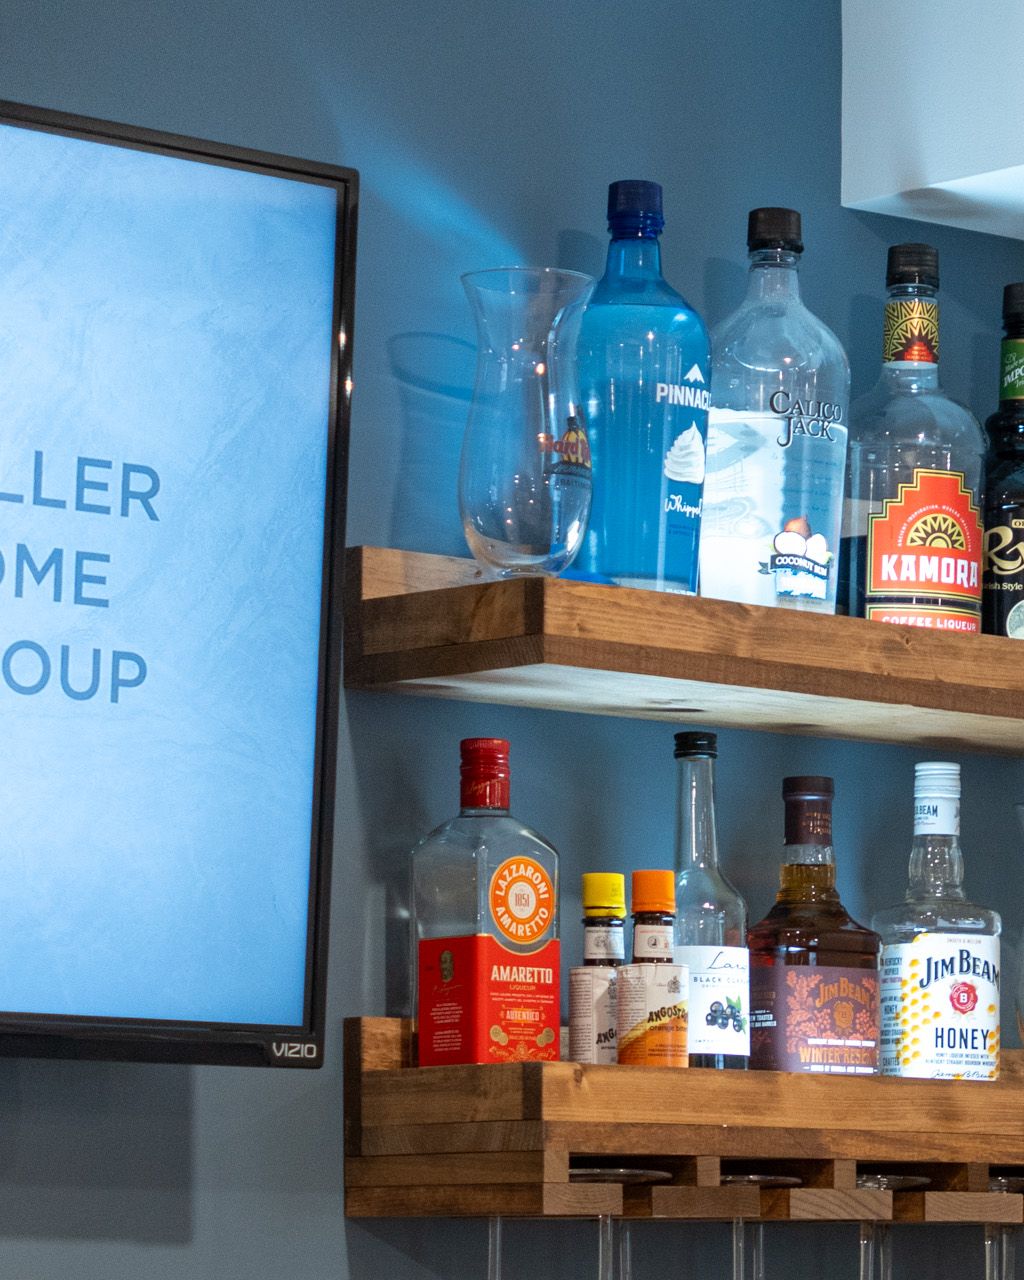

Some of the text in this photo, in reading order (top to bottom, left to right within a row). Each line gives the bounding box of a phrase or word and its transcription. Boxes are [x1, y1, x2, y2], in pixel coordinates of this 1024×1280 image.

[777, 416, 837, 448] JACK
[775, 556, 814, 571] COCONUT
[881, 554, 979, 588] KAMORA
[1002, 582, 1023, 592] Style
[936, 617, 976, 631] LIQUEUR
[2, 640, 147, 704] OUP
[495, 864, 550, 899] LAZZARONI
[496, 907, 549, 936] AMARETTO
[490, 965, 553, 984] AMARETTO
[919, 949, 1000, 993] JIM BEAM
[815, 982, 838, 1008] JIM
[272, 1042, 317, 1058] VIZIO
[935, 1028, 989, 1051] HONEY
[799, 1046, 840, 1064] WINTER
